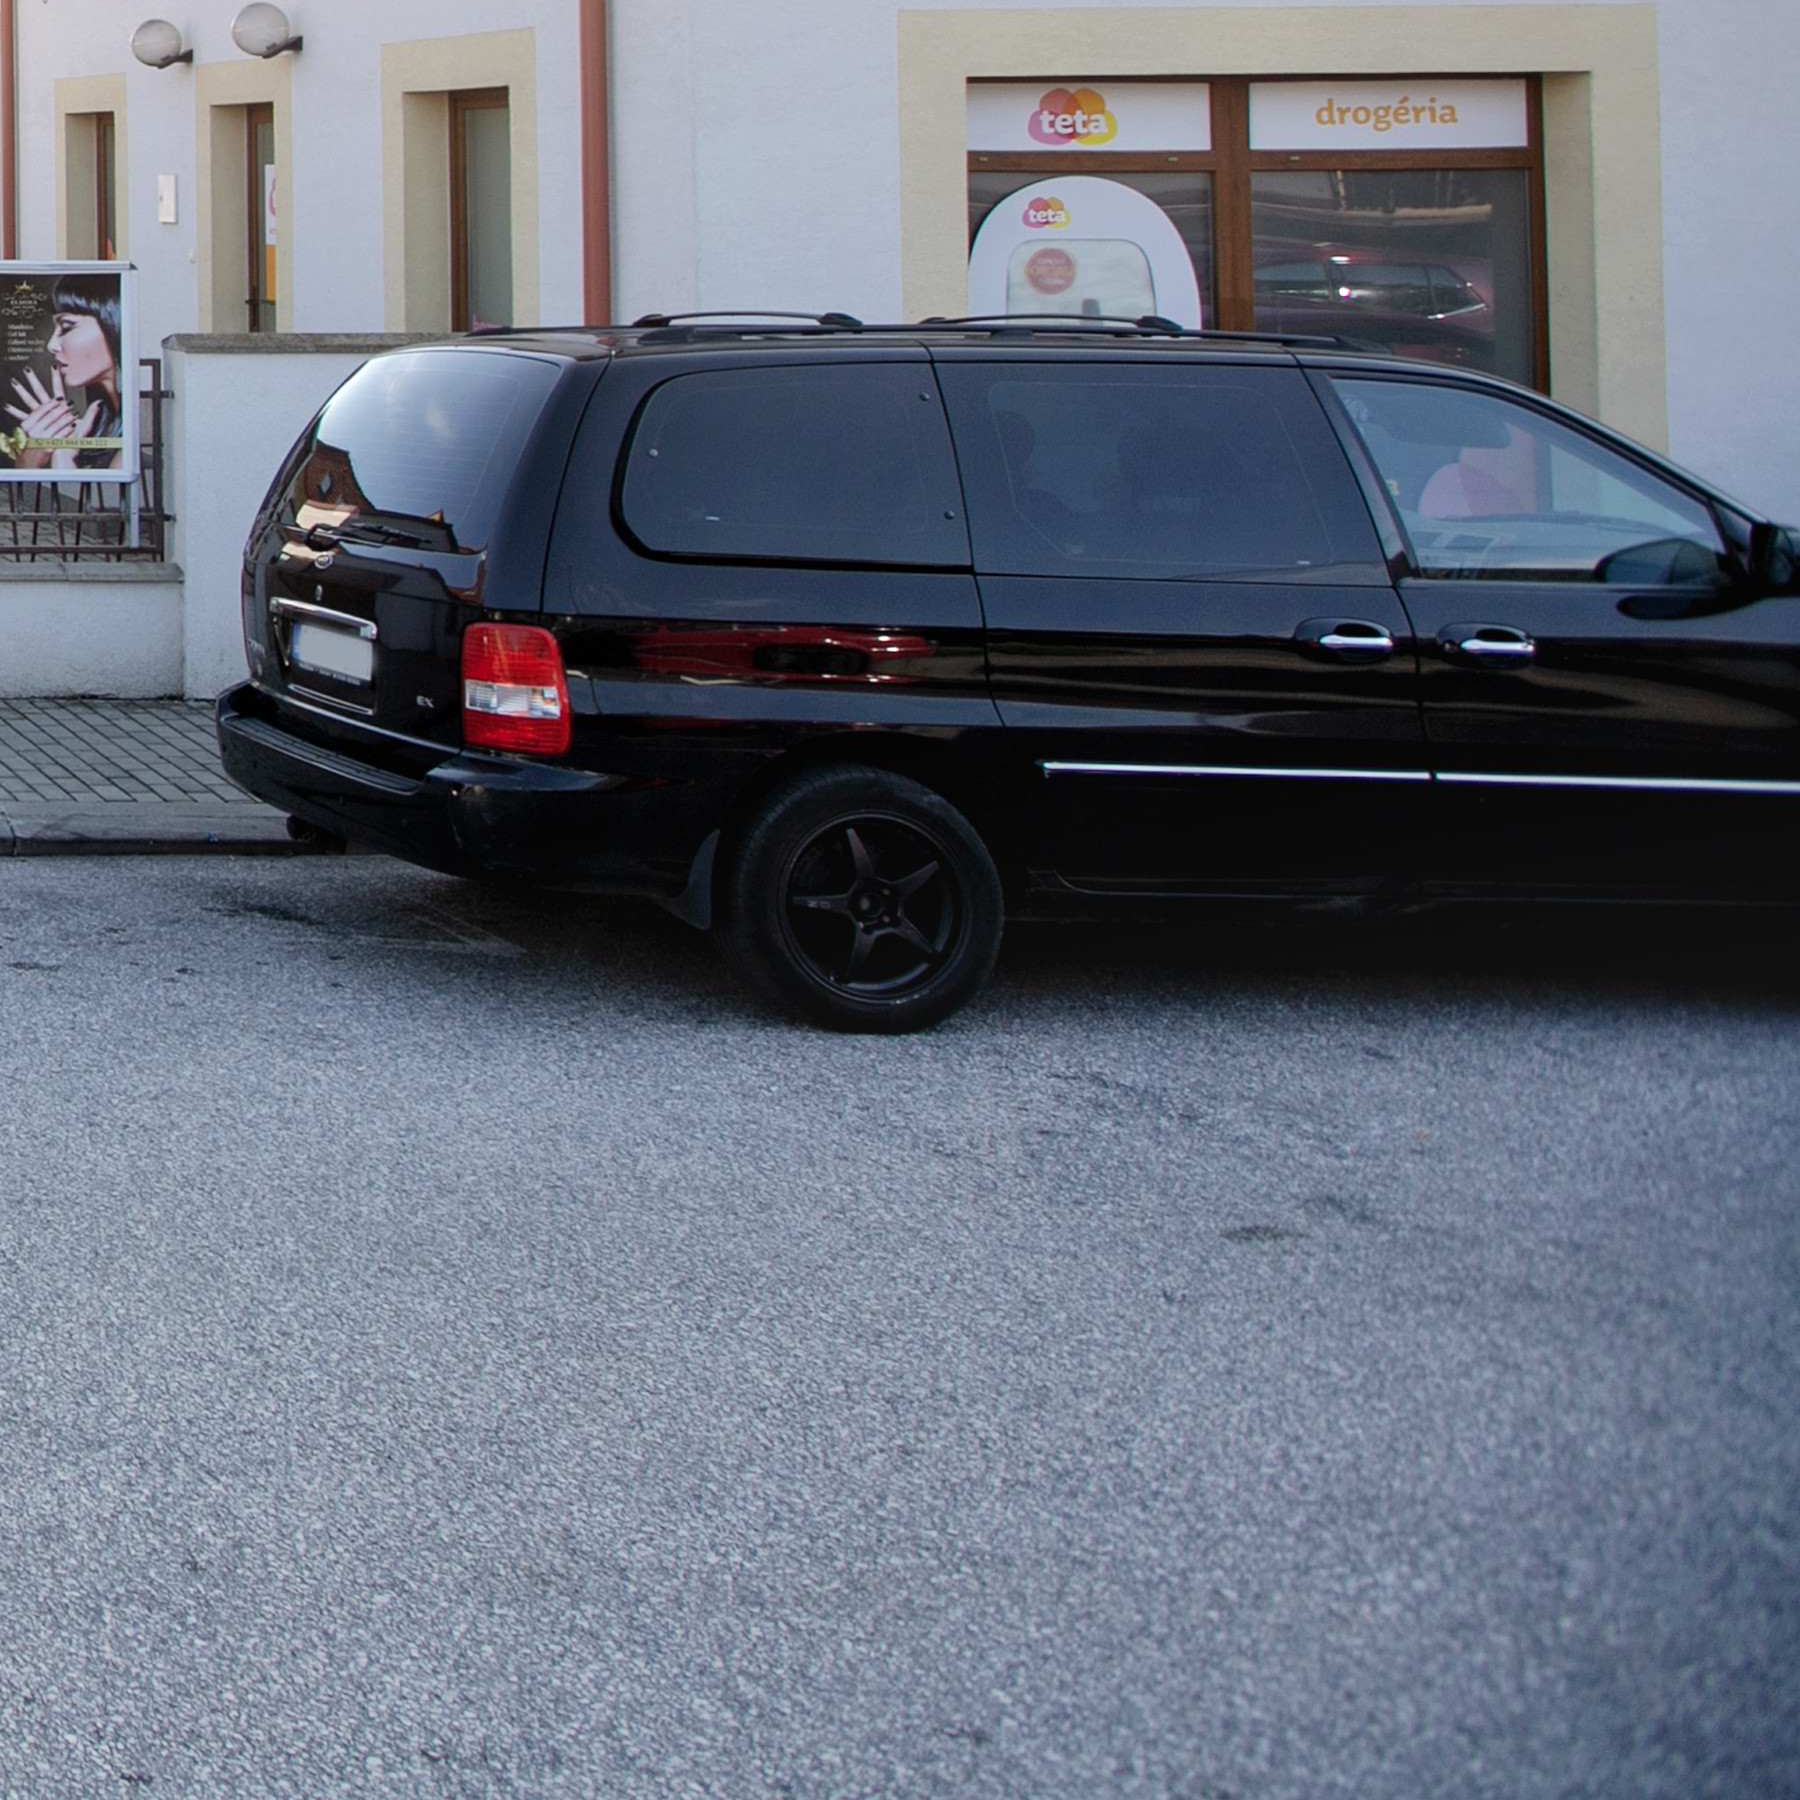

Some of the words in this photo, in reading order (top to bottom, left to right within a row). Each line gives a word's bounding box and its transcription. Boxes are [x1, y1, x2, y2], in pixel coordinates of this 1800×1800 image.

[1038, 107, 1108, 136] teta
[1315, 94, 1458, 132] drogéria
[1028, 209, 1066, 222] teta
[416, 695, 434, 708] EX
